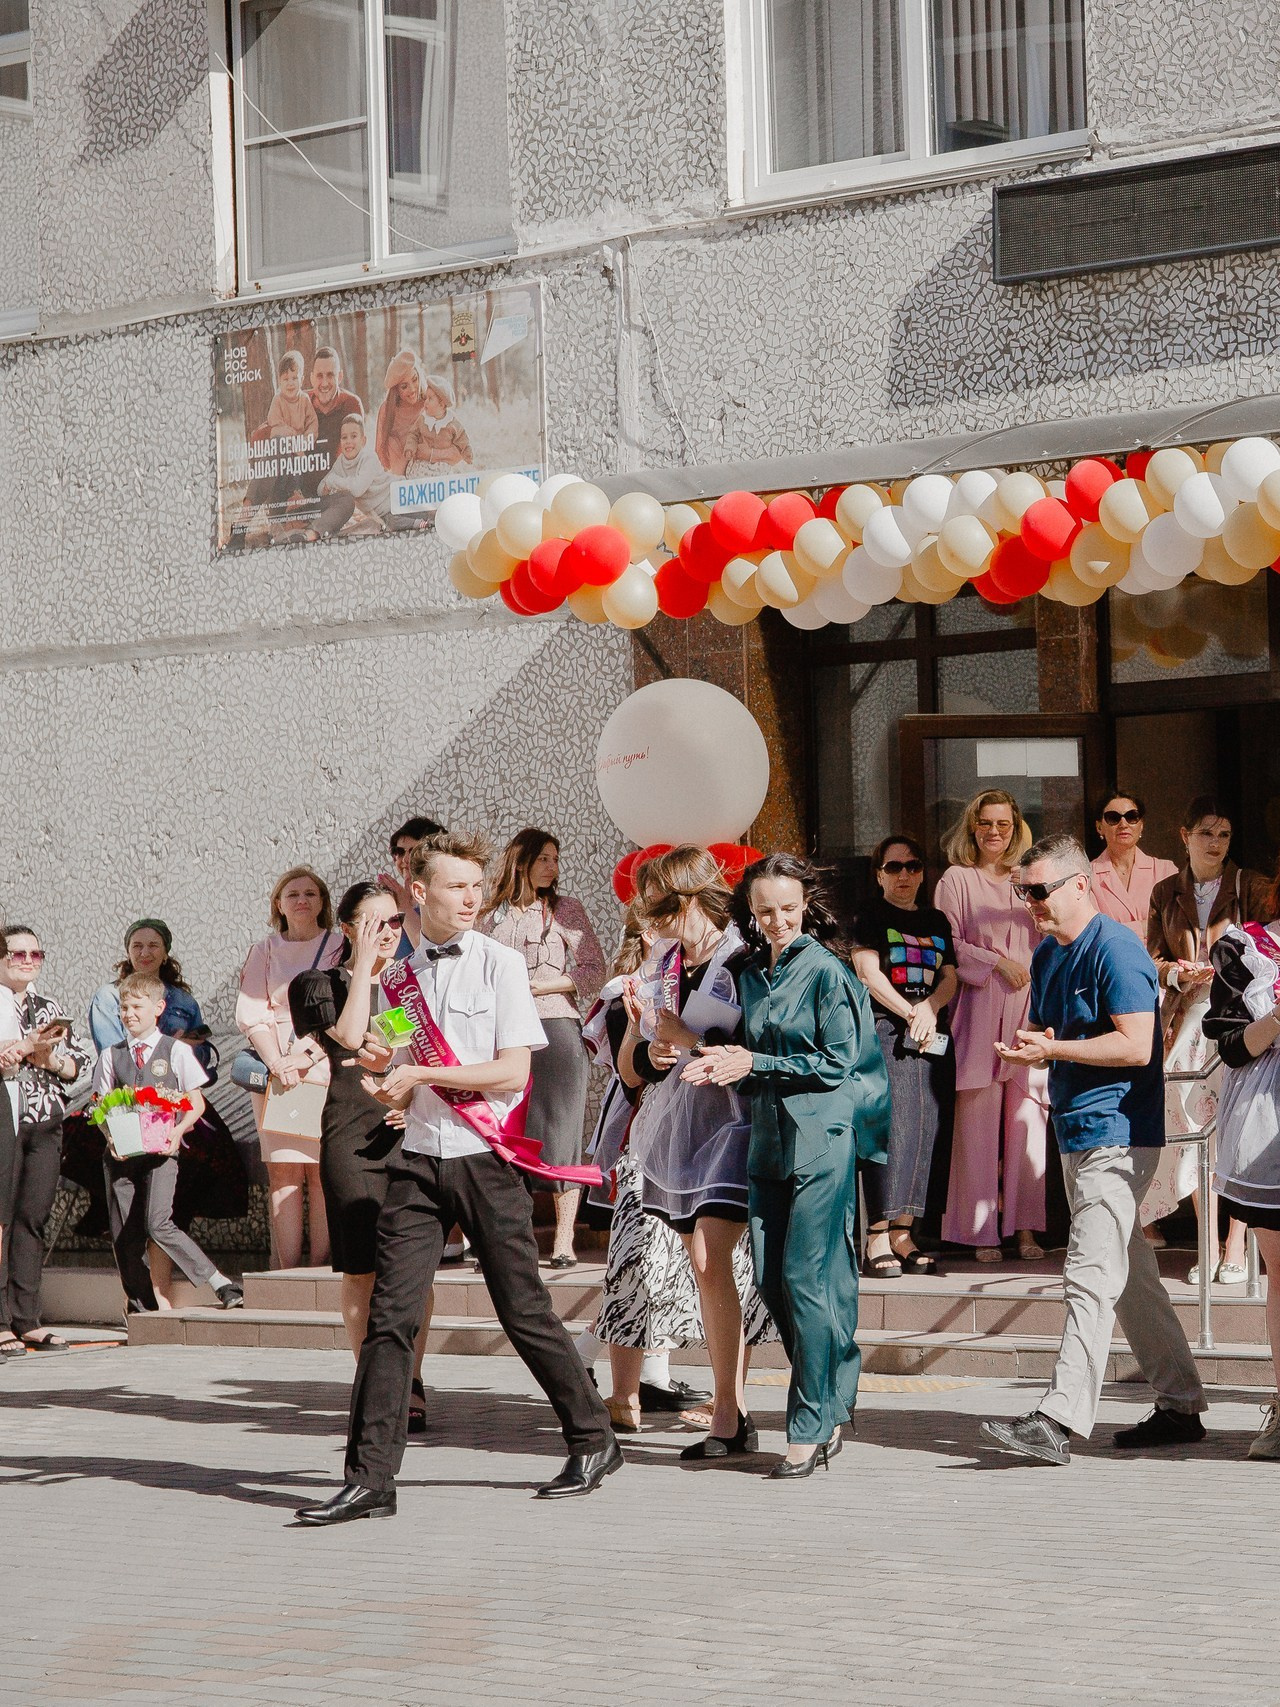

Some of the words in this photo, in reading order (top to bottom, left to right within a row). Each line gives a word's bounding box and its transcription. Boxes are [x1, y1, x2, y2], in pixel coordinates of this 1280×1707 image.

[224, 346, 248, 361] НОВ
[224, 359, 248, 373] РОС
[224, 369, 262, 385] СИЙСК
[279, 433, 314, 455] СЕМЬЯ
[228, 459, 278, 483] БОЛЬШАЯ
[280, 452, 330, 476] РАДОСТЬ!
[399, 481, 445, 507] ВАЖНО
[449, 477, 480, 497] БЫТ
